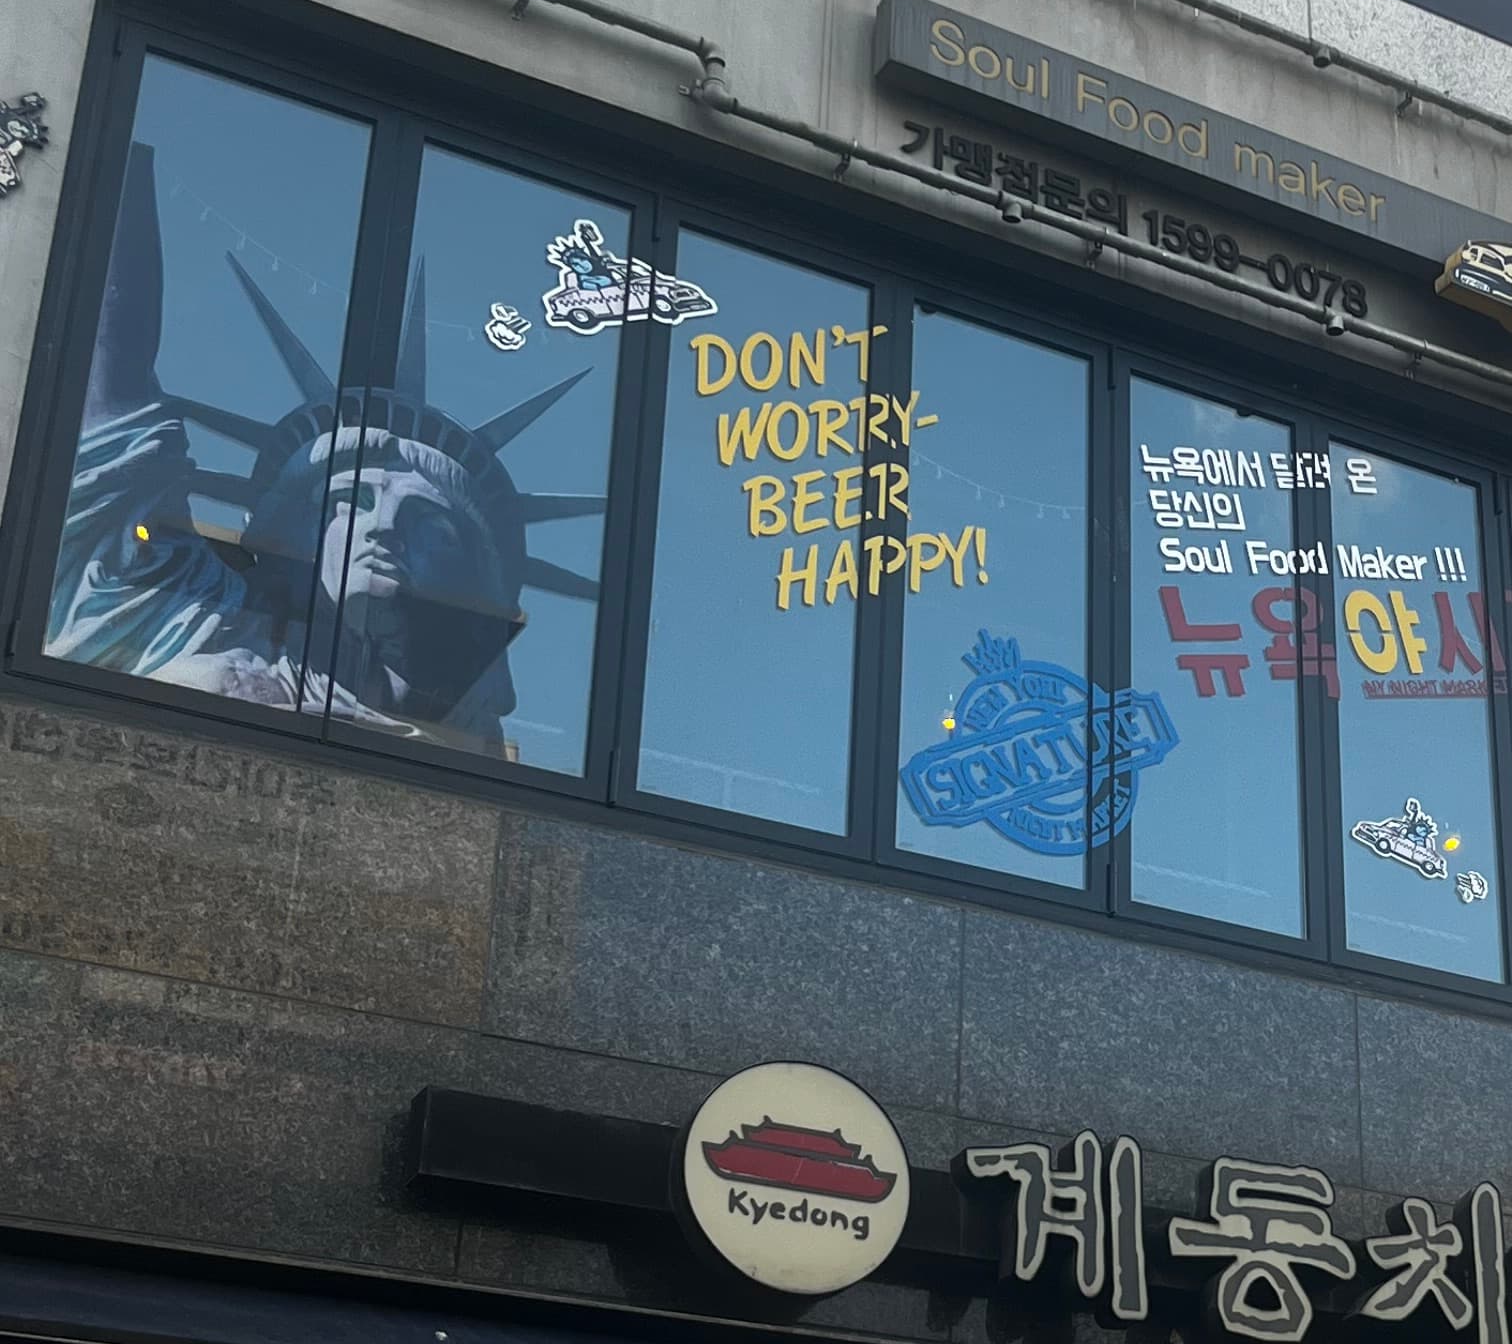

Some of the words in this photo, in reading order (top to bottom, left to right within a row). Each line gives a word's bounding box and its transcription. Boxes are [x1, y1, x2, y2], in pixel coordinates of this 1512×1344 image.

[928, 18, 1050, 100] Soul
[1076, 71, 1210, 160] Food
[1233, 140, 1387, 224] maker
[1139, 443, 1267, 489] 뉴욕에서
[1345, 457, 1378, 495] 온
[742, 463, 913, 539] BEER
[1148, 488, 1246, 532] 당신의
[775, 525, 990, 611] HAPPY!
[1159, 537, 1233, 575] Soul
[1245, 541, 1328, 576] Food
[1336, 544, 1428, 581] Maker
[727, 1189, 870, 1241] Kyedong
